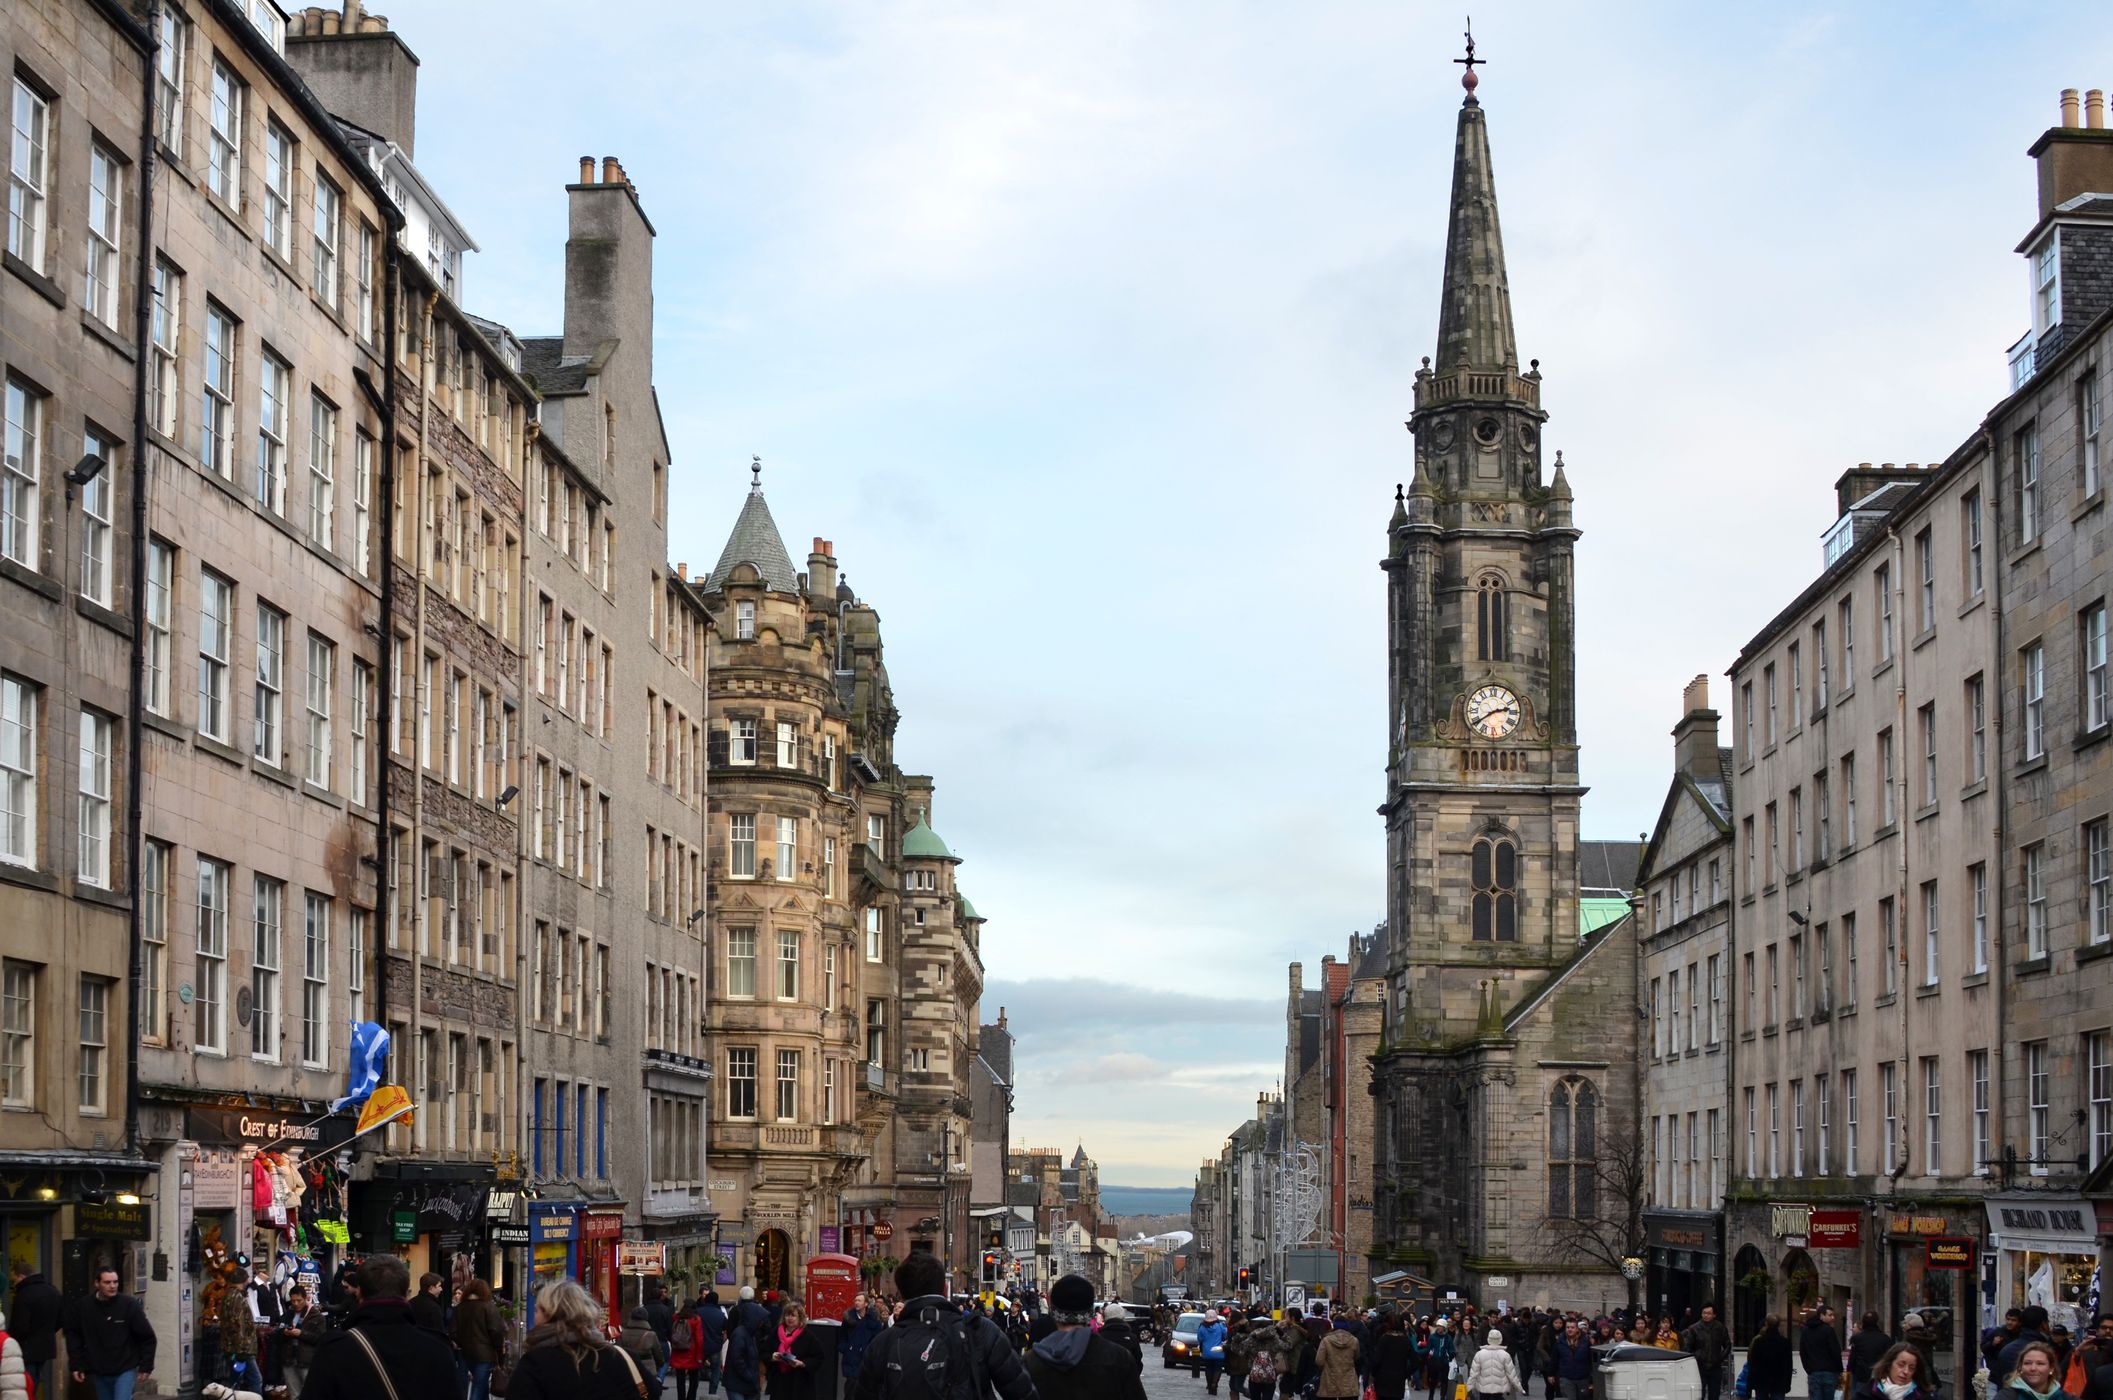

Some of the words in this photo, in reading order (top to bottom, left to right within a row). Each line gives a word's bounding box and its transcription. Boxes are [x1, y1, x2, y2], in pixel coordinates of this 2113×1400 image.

[152, 1111, 172, 1133] 219
[240, 1116, 266, 1137] CREST
[267, 1123, 279, 1138] OF
[280, 1119, 320, 1140] EDINBURGH
[487, 1192, 515, 1208] RAJPUT
[80, 1206, 114, 1220] Single
[117, 1209, 144, 1222] Malt
[2001, 1208, 2046, 1229] HIGHLAND
[2048, 1210, 2085, 1230] HOUSE
[501, 1229, 529, 1237] INDIAN
[1813, 1223, 1857, 1232] GARFUNKEL'S
